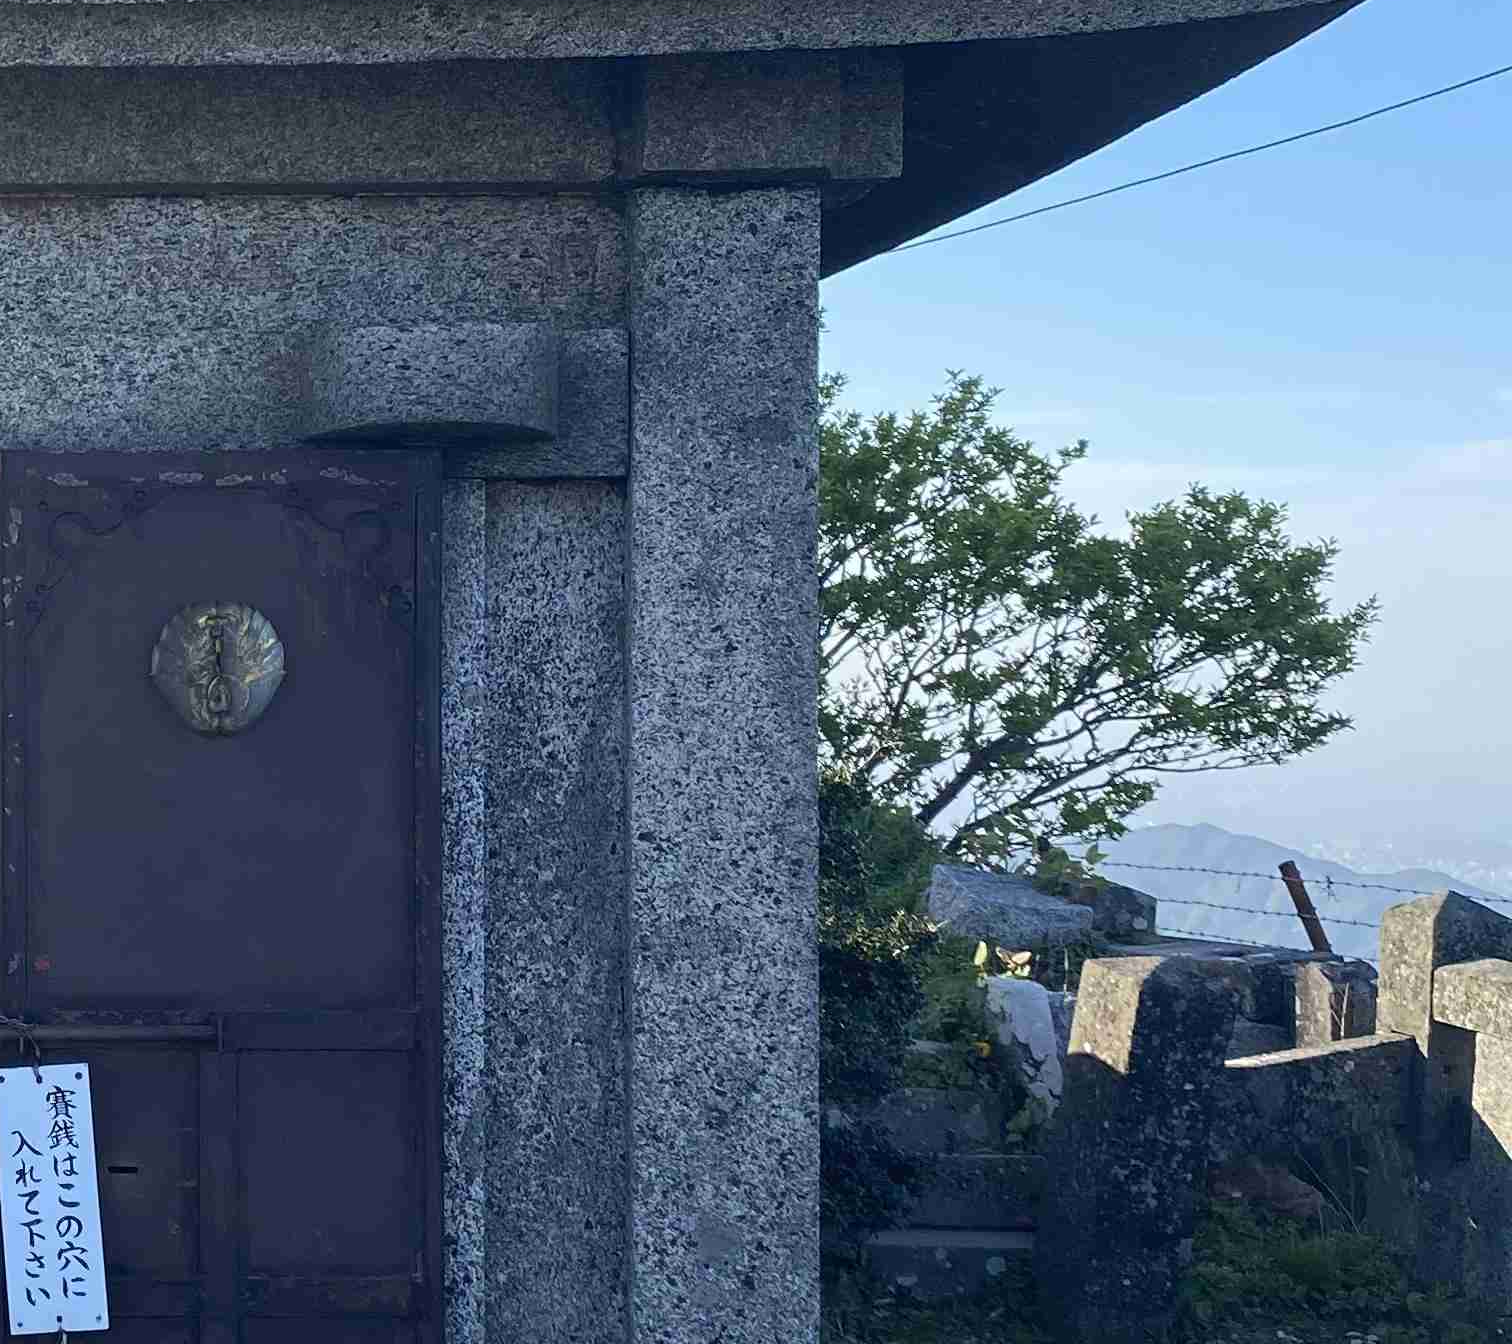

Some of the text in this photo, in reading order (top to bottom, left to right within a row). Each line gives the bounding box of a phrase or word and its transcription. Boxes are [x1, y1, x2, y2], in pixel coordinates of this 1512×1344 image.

[10, 1130, 51, 1307] 入れて下さい
[45, 1085, 90, 1299] 賽銭はこの穴に
